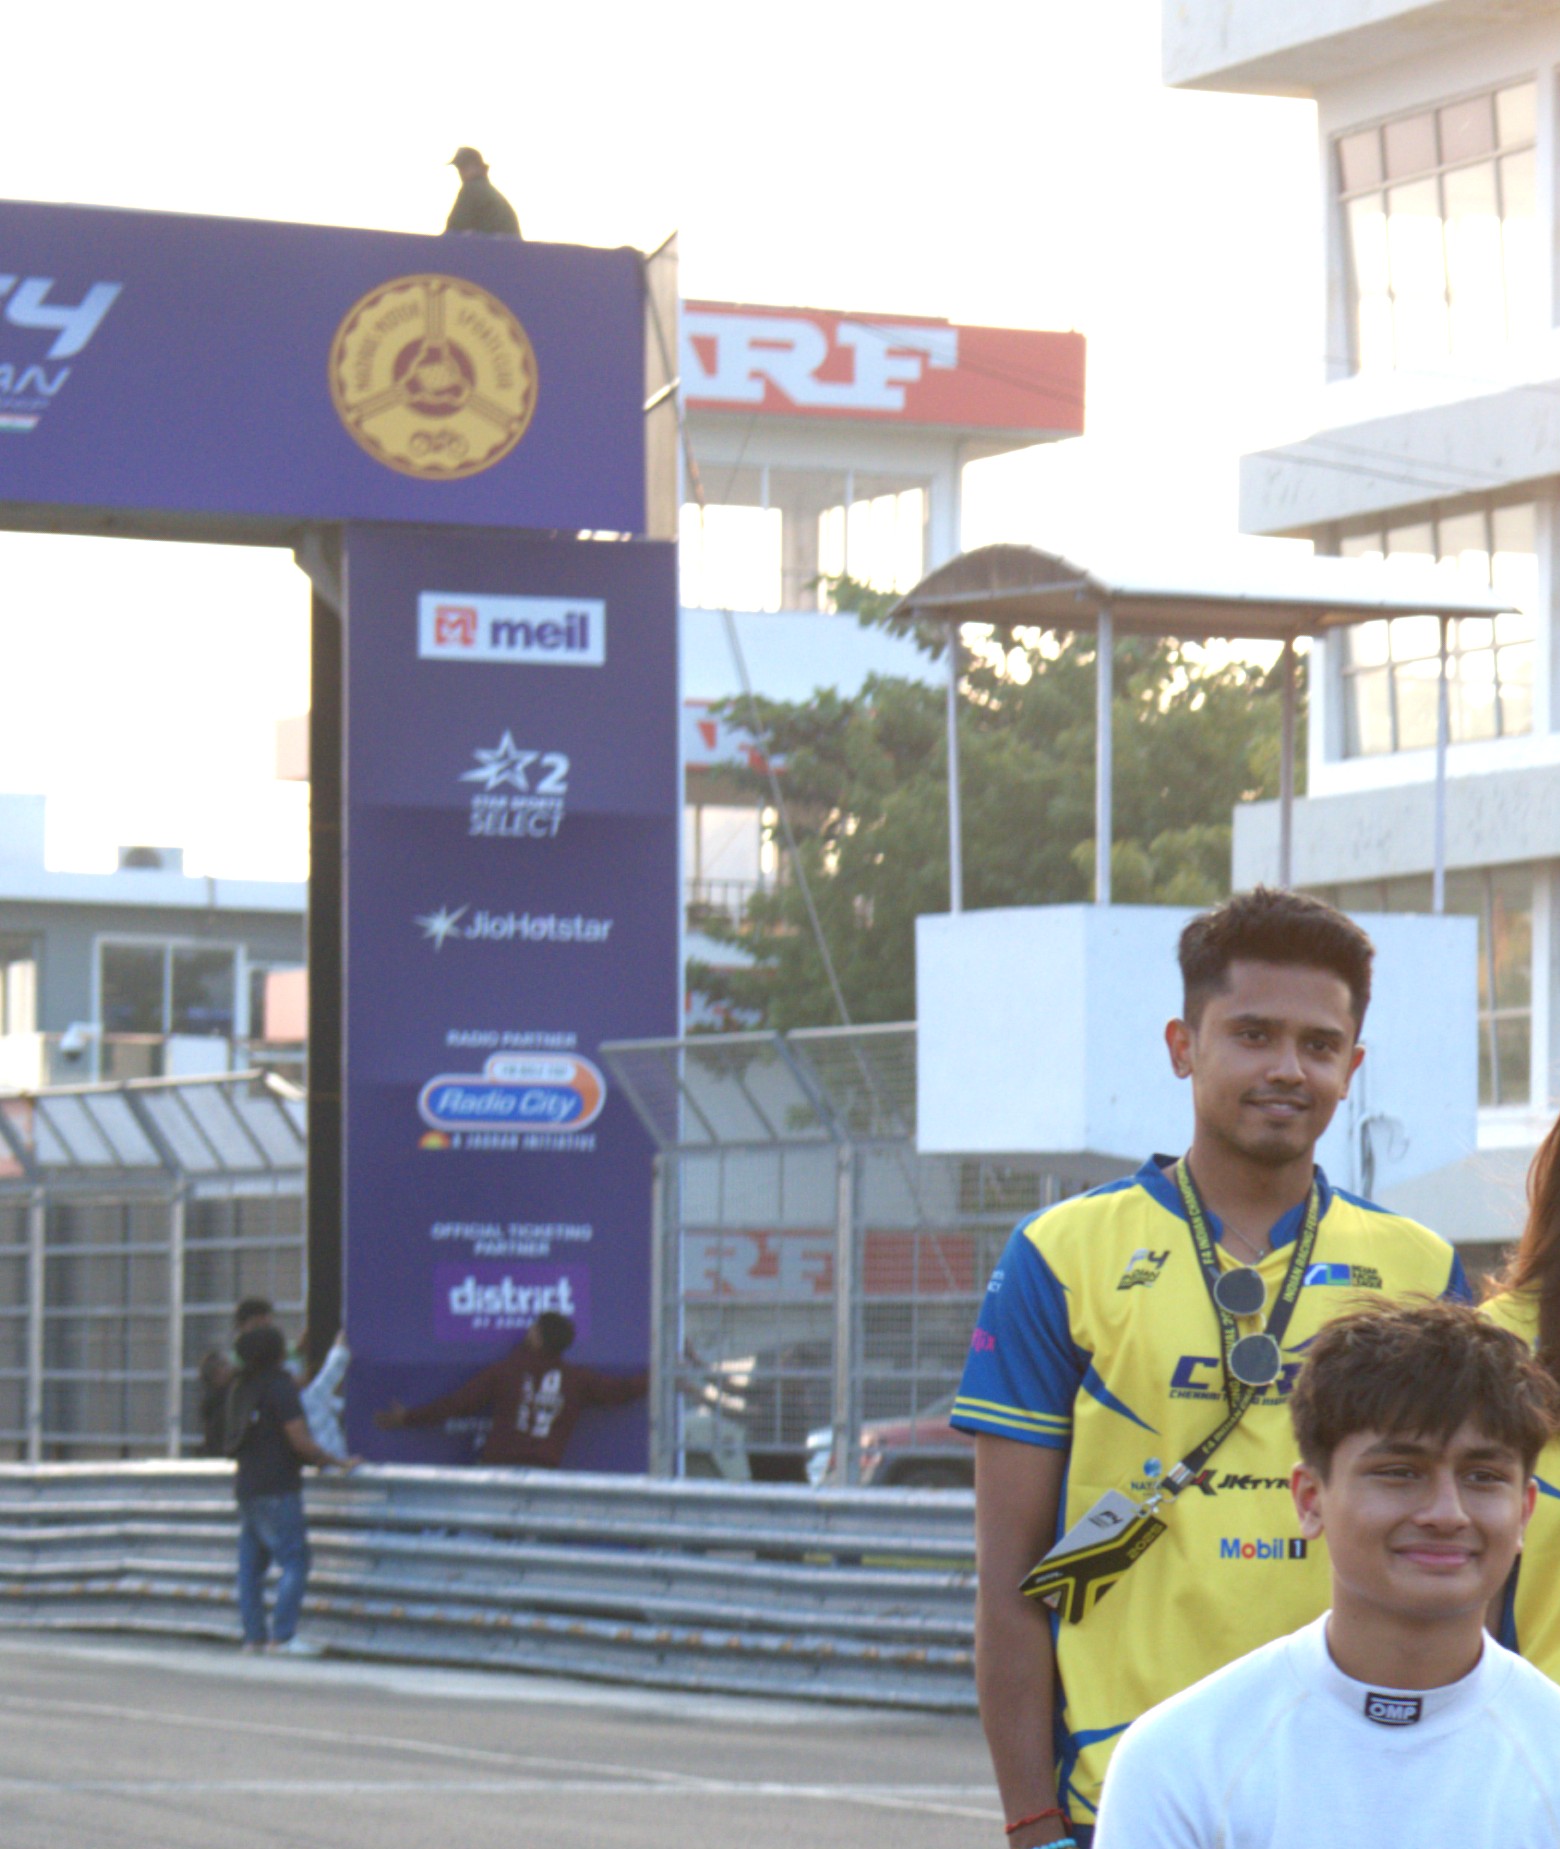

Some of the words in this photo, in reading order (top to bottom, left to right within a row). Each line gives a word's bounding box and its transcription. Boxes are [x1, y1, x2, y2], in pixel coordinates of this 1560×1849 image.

[489, 612, 590, 651] meil
[535, 752, 570, 794] 2
[468, 809, 566, 838] SELECT
[464, 910, 614, 941] JioHotstar
[446, 1029, 499, 1047] RADIO
[502, 1030, 577, 1048] PARTNER
[437, 1089, 516, 1117] Radio
[519, 1092, 577, 1122] City
[430, 1221, 504, 1241] OFFICIAL
[507, 1223, 593, 1242] TICKETING
[473, 1240, 550, 1256] PARTNER
[450, 1275, 574, 1315] district
[1219, 1538, 1284, 1559] Mobil
[1290, 1539, 1306, 1558] 1
[1368, 1703, 1417, 1721] OMP
